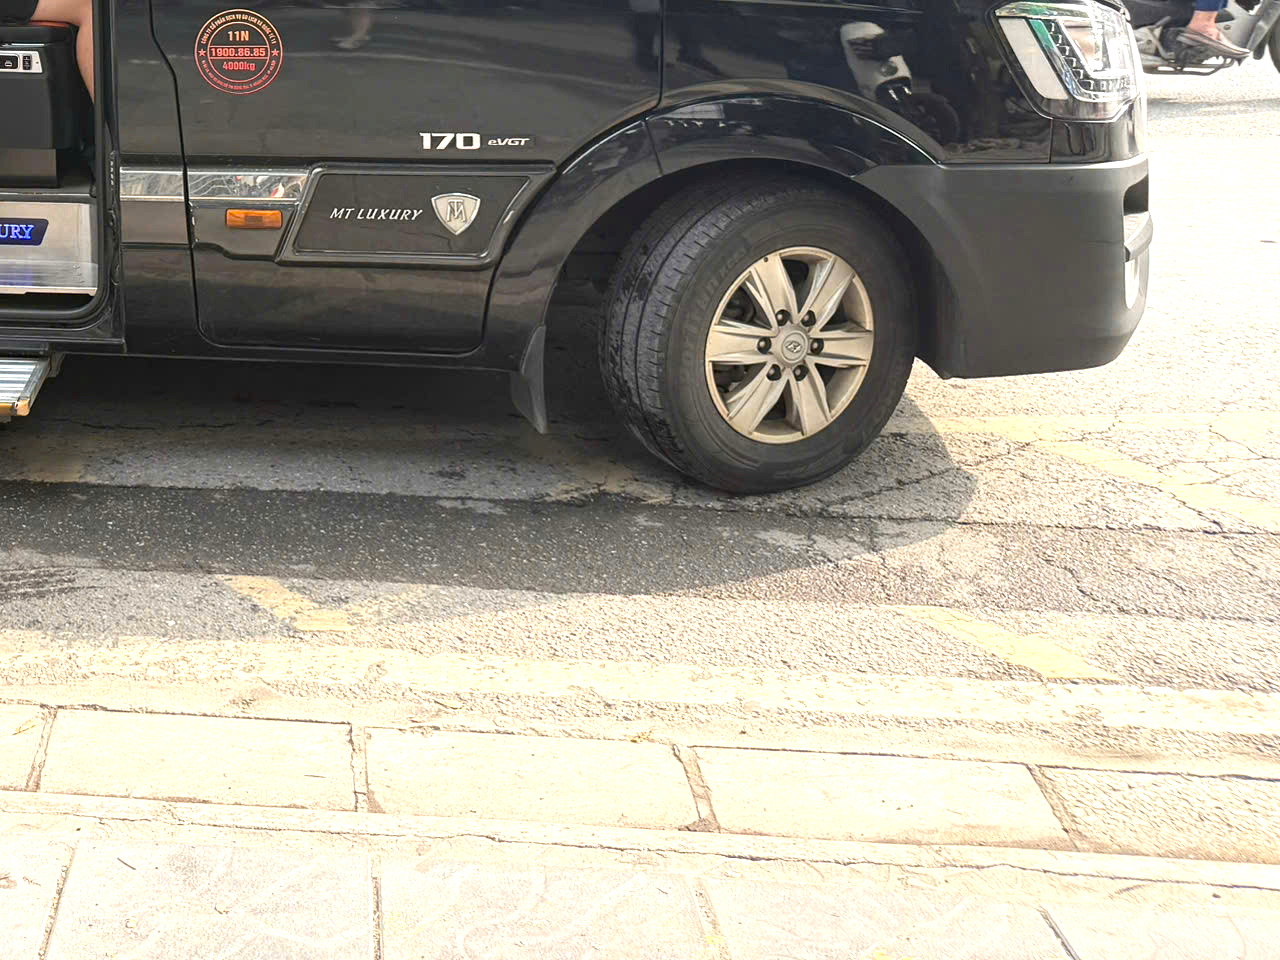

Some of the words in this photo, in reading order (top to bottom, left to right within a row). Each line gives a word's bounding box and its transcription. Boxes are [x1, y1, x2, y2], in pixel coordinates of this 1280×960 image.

[227, 31, 249, 41] 11N
[210, 48, 266, 57] 1900.86.85
[222, 61, 256, 72] 4000kg
[419, 132, 481, 150] 170
[487, 138, 531, 146] eVGT
[329, 207, 355, 219] MT
[356, 208, 424, 221] LUXURY
